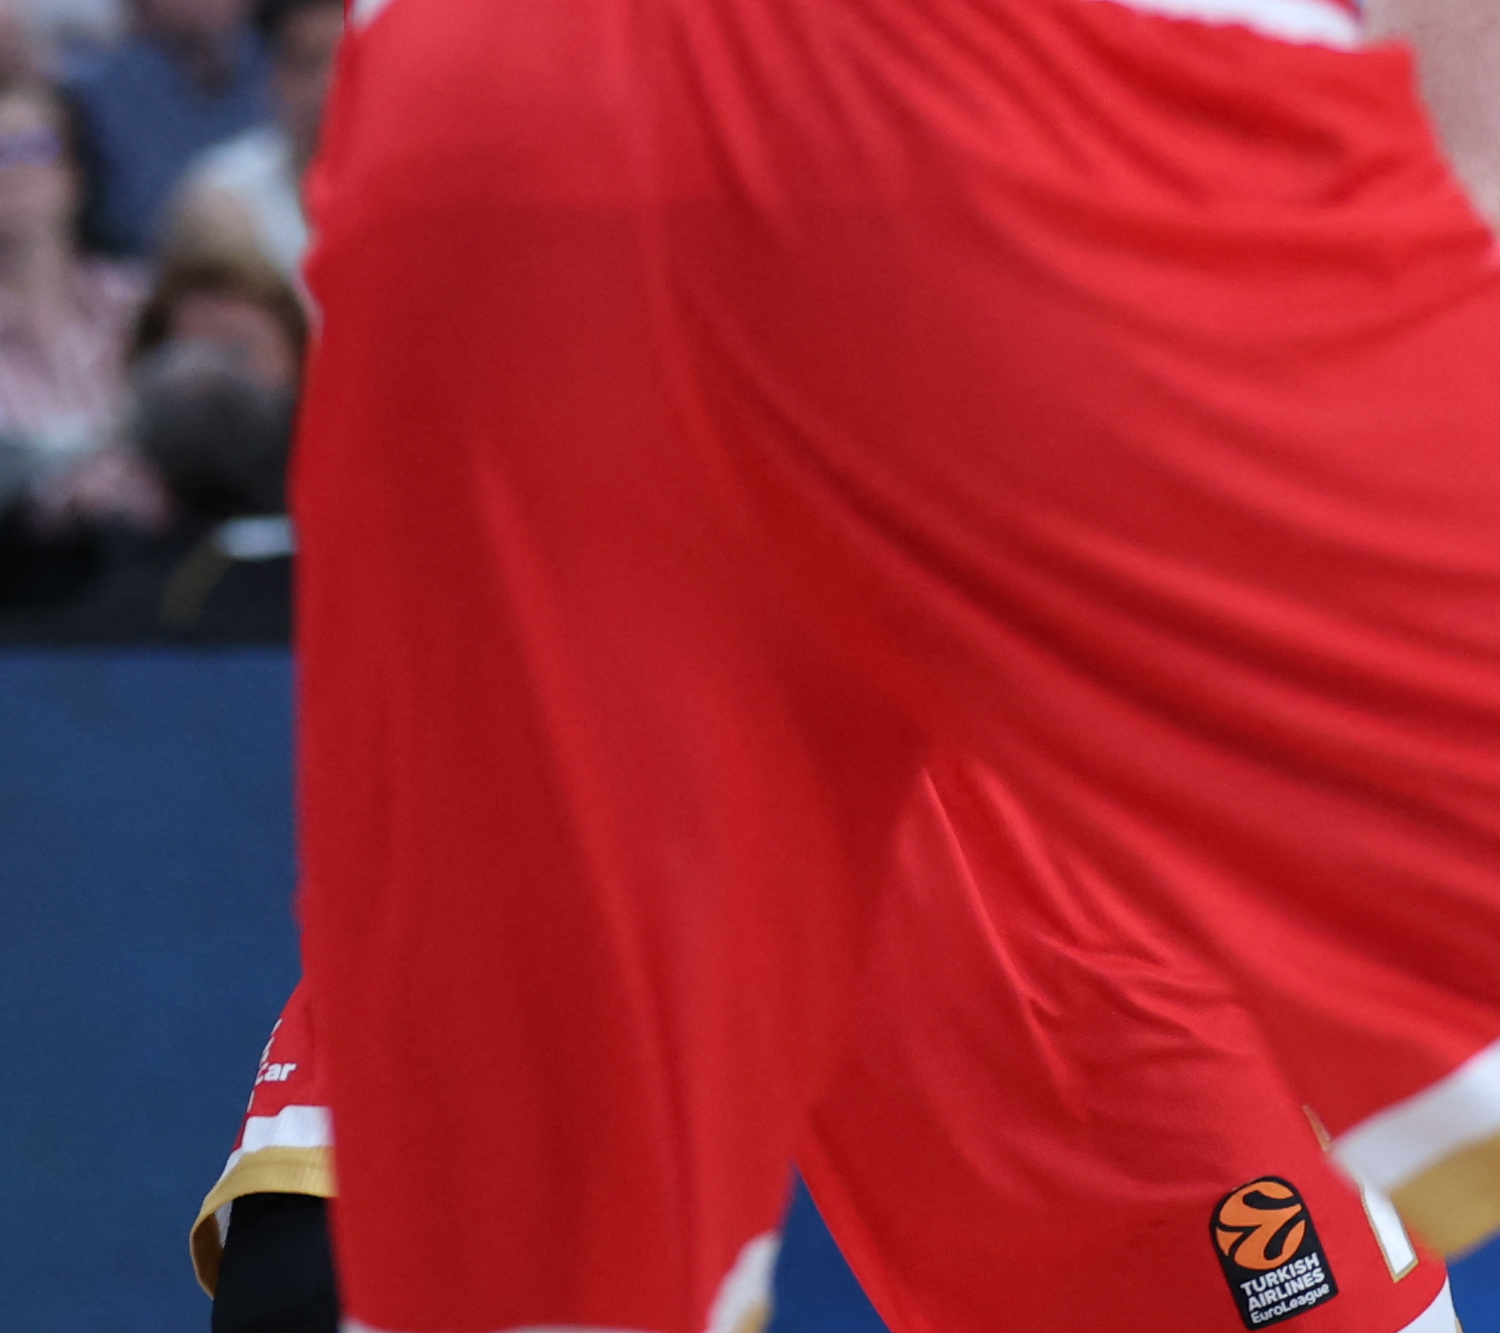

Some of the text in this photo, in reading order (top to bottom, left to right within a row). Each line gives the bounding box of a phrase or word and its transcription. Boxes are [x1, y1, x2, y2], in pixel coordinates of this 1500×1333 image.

[1240, 1252, 1320, 1296] TURKISH
[1248, 1268, 1325, 1312] AIRLINES
[1250, 1284, 1330, 1324] EuroLeague
